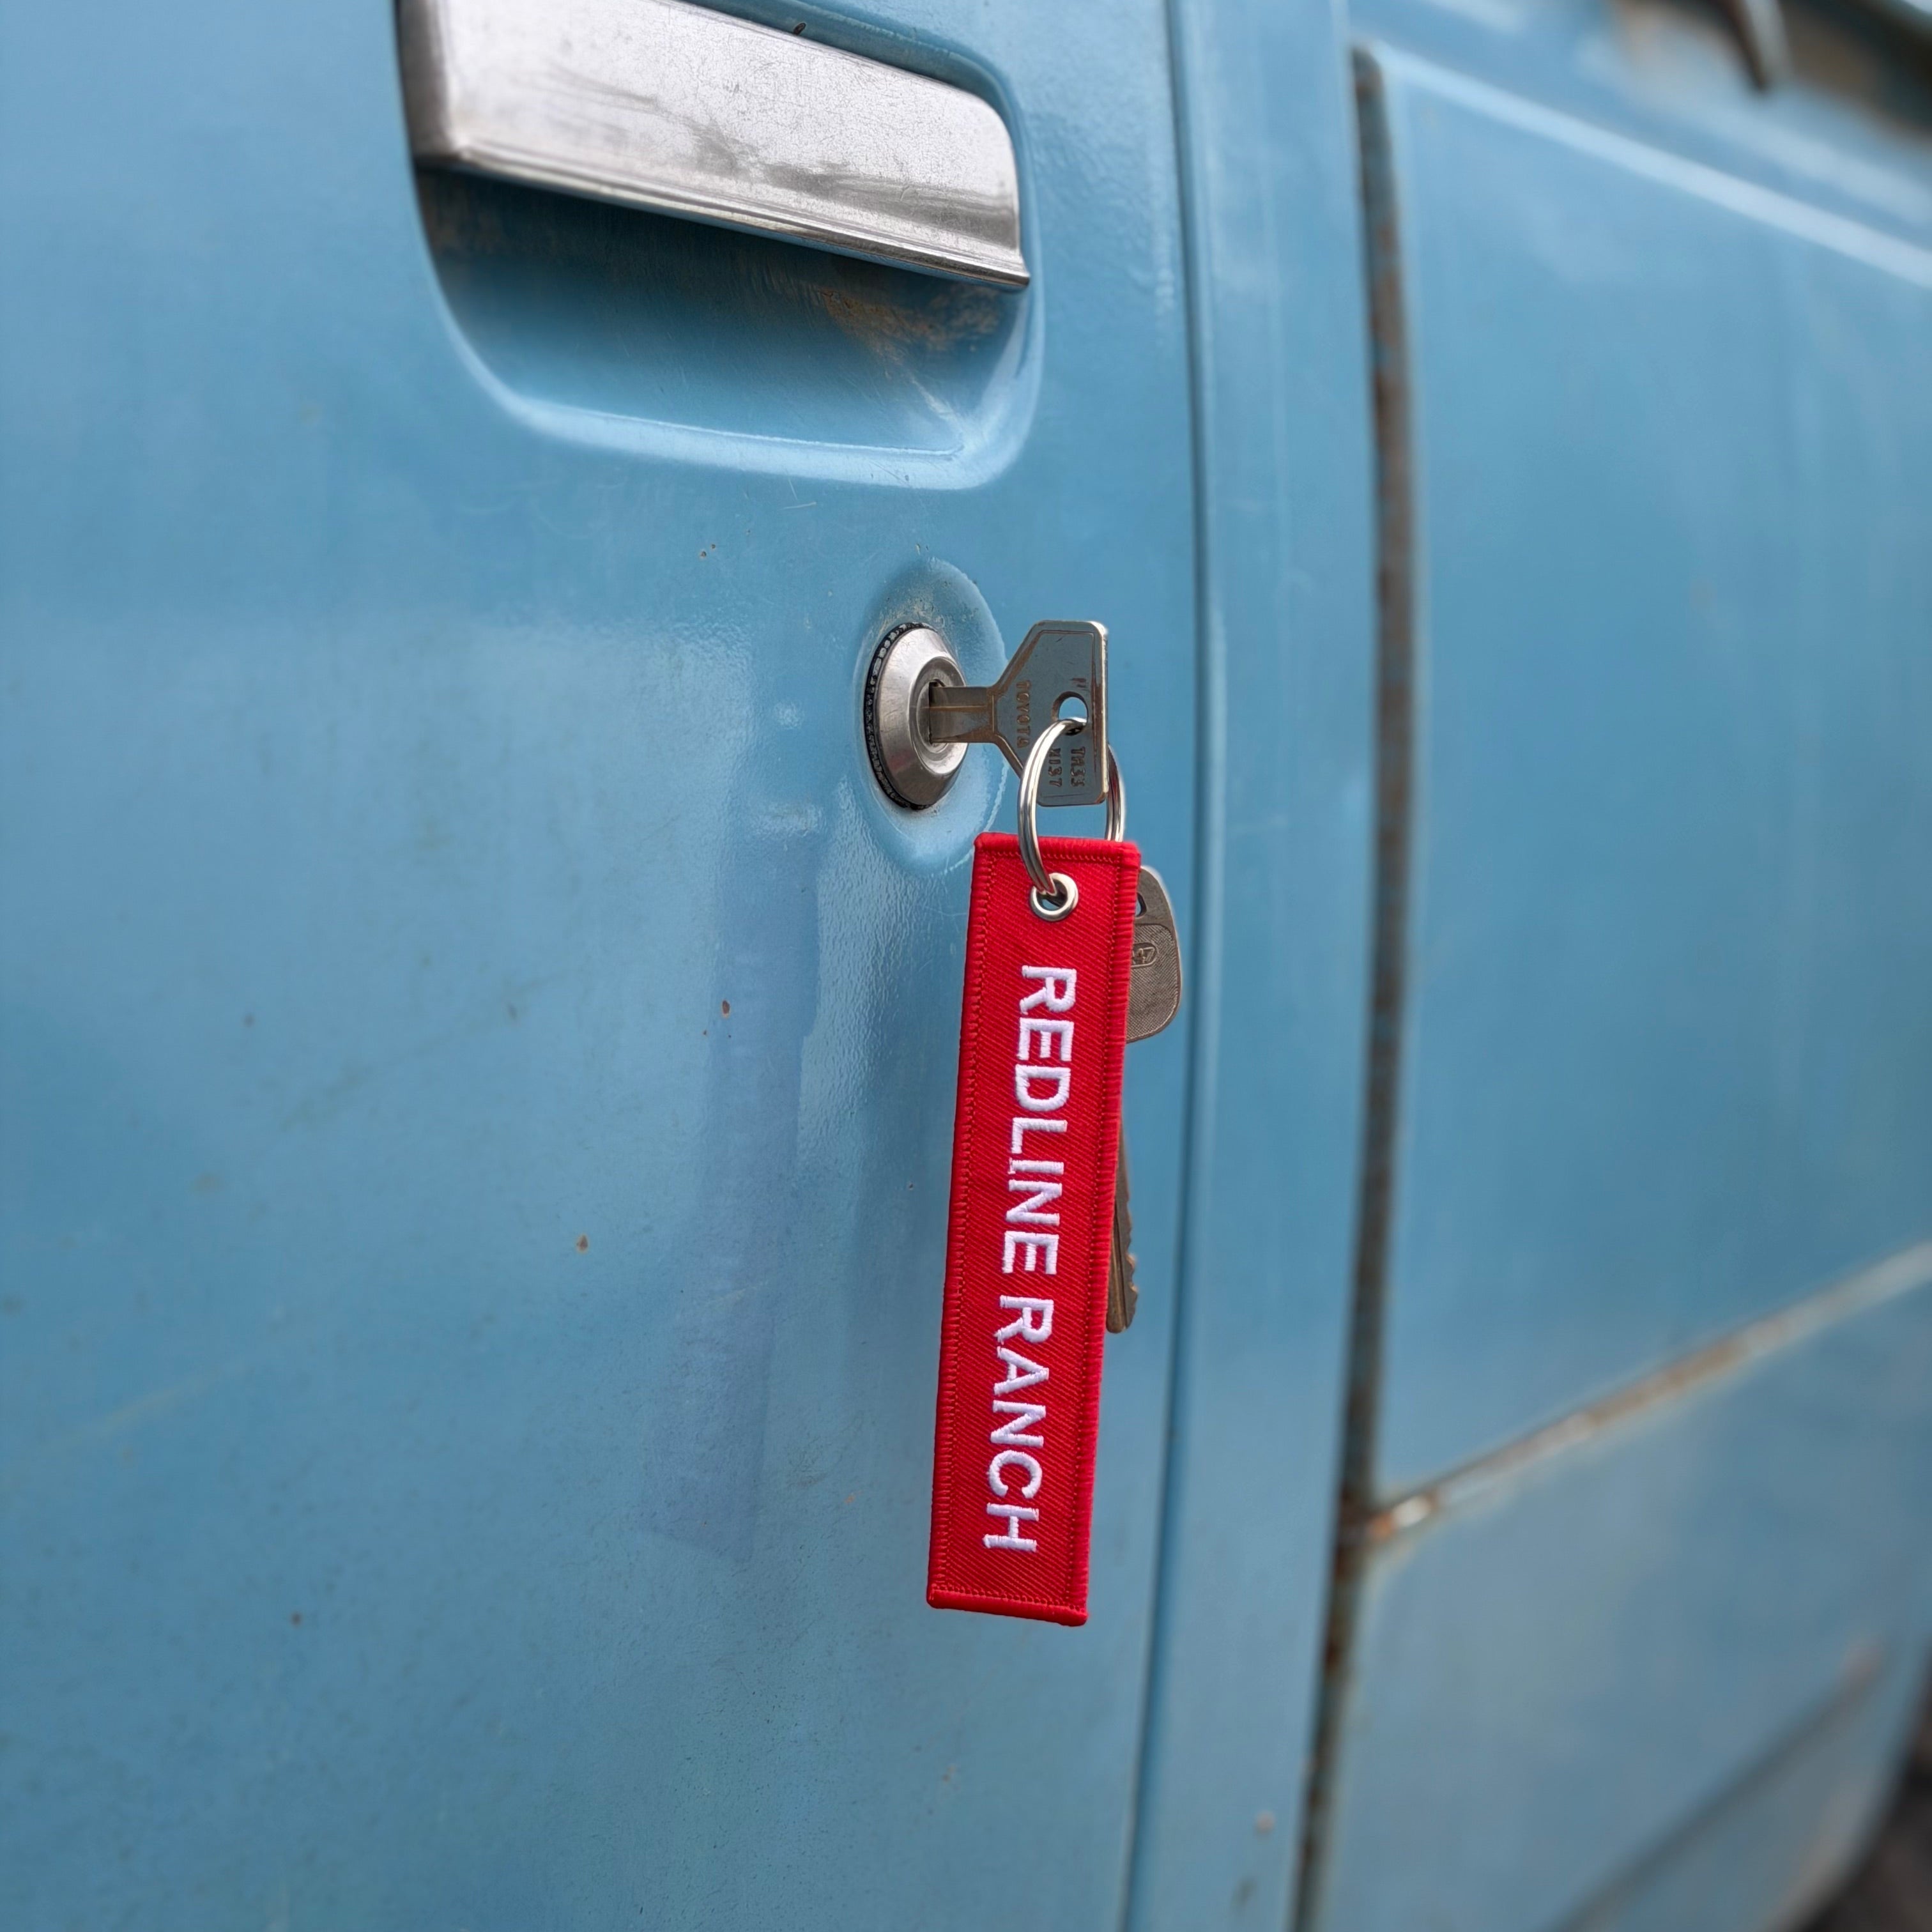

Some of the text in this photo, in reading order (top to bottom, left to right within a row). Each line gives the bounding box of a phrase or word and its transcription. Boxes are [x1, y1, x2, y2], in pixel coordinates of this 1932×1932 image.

[1016, 679, 1032, 749] TOYOTA
[983, 965, 1077, 1551] REDLINE RANCH
